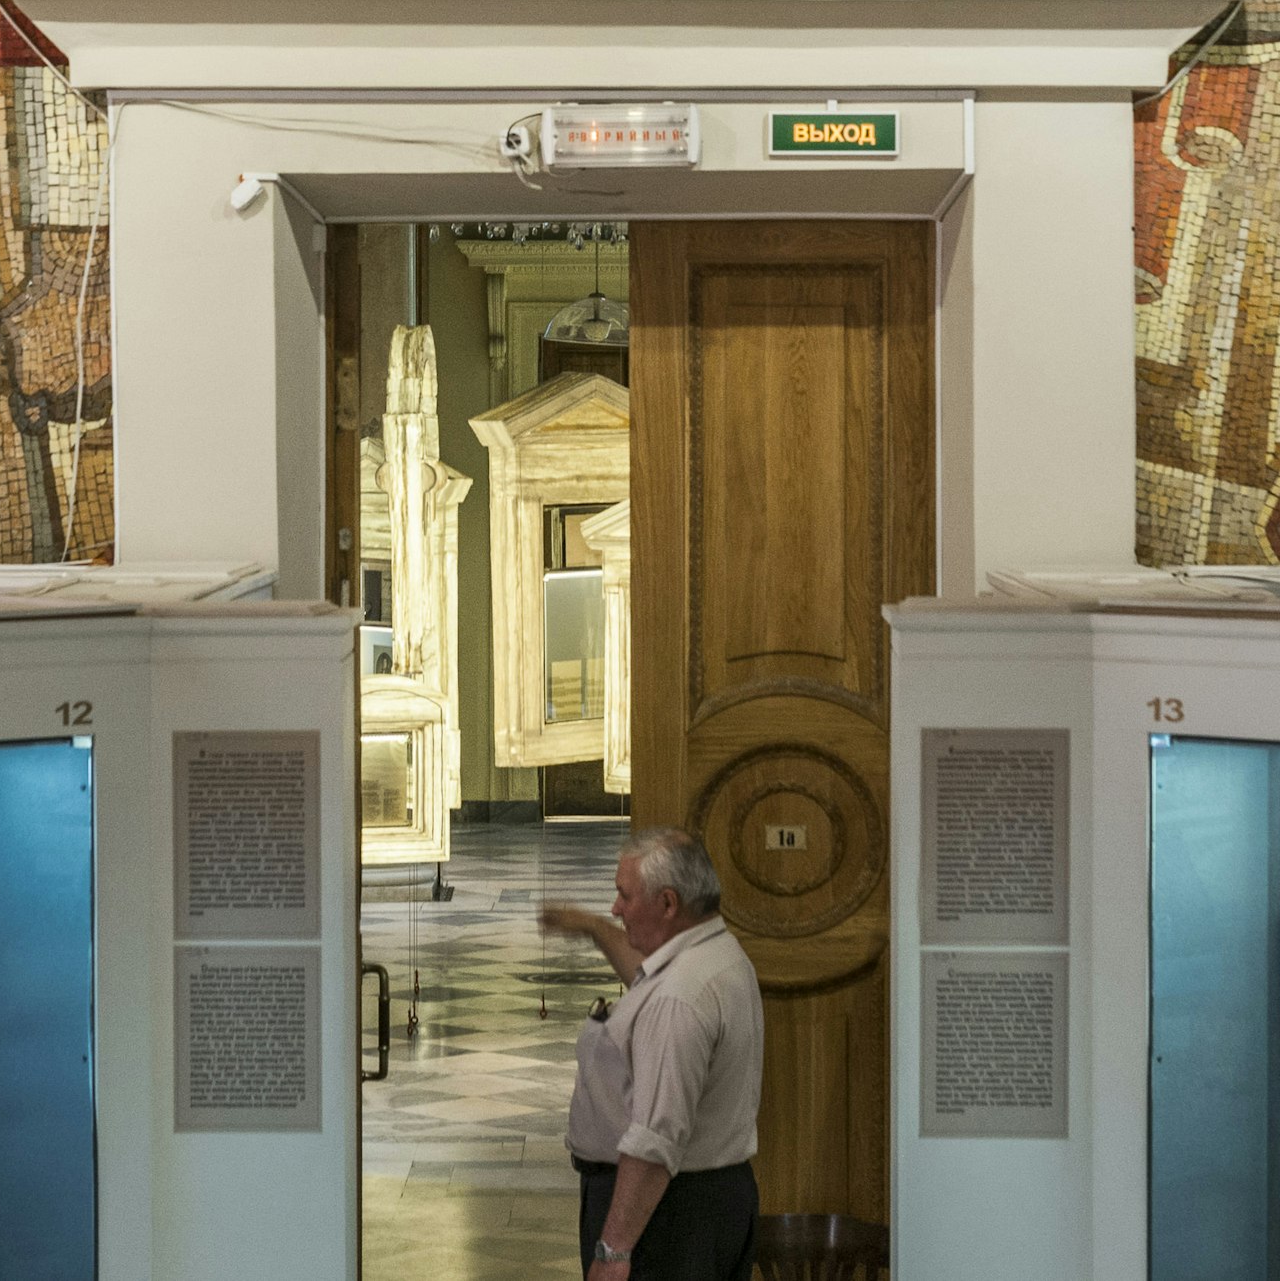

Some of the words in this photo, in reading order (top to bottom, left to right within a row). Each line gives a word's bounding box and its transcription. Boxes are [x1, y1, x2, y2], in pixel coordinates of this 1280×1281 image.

[793, 122, 876, 145] ВЫХОД
[56, 701, 93, 726] 12
[1146, 698, 1185, 722] 13
